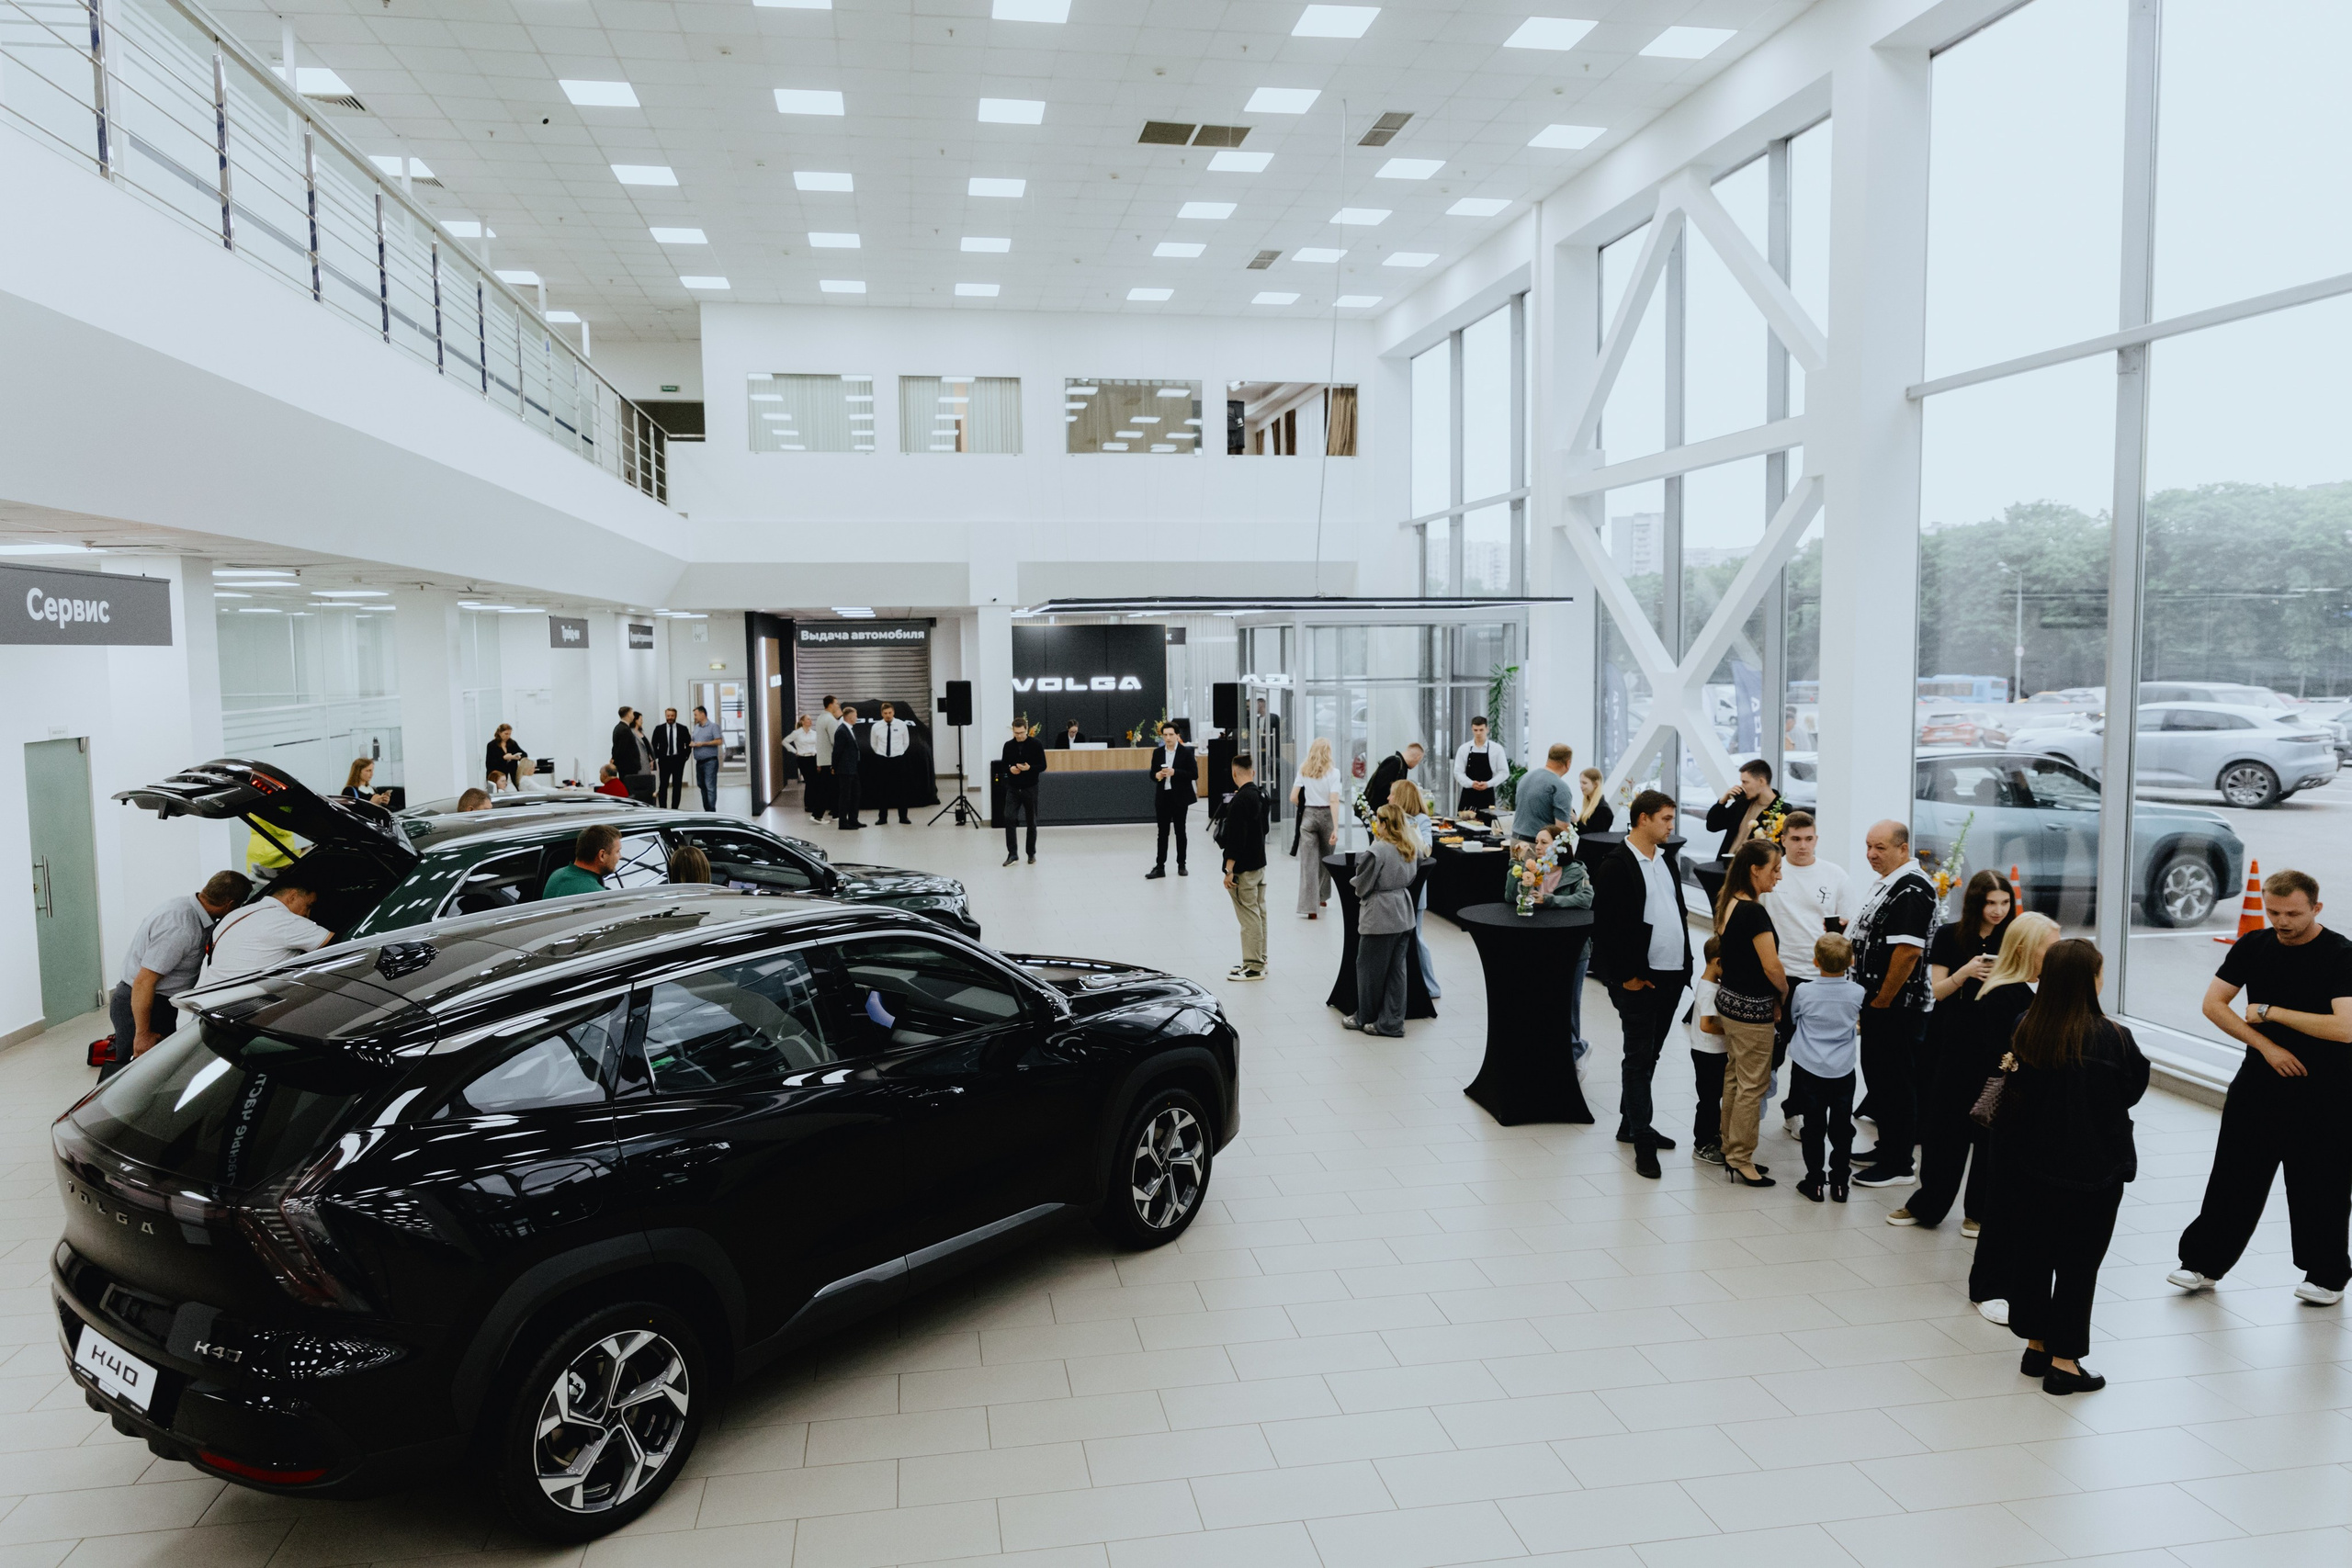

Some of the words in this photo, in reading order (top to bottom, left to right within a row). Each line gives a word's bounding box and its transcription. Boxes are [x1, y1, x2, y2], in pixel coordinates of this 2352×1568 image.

[27, 587, 110, 629] Сервис
[800, 630, 849, 642] Выдача
[851, 629, 925, 640] автомобиля
[1012, 676, 1142, 692] VOLGA
[194, 1340, 243, 1363] K40
[91, 1344, 139, 1388] K40
